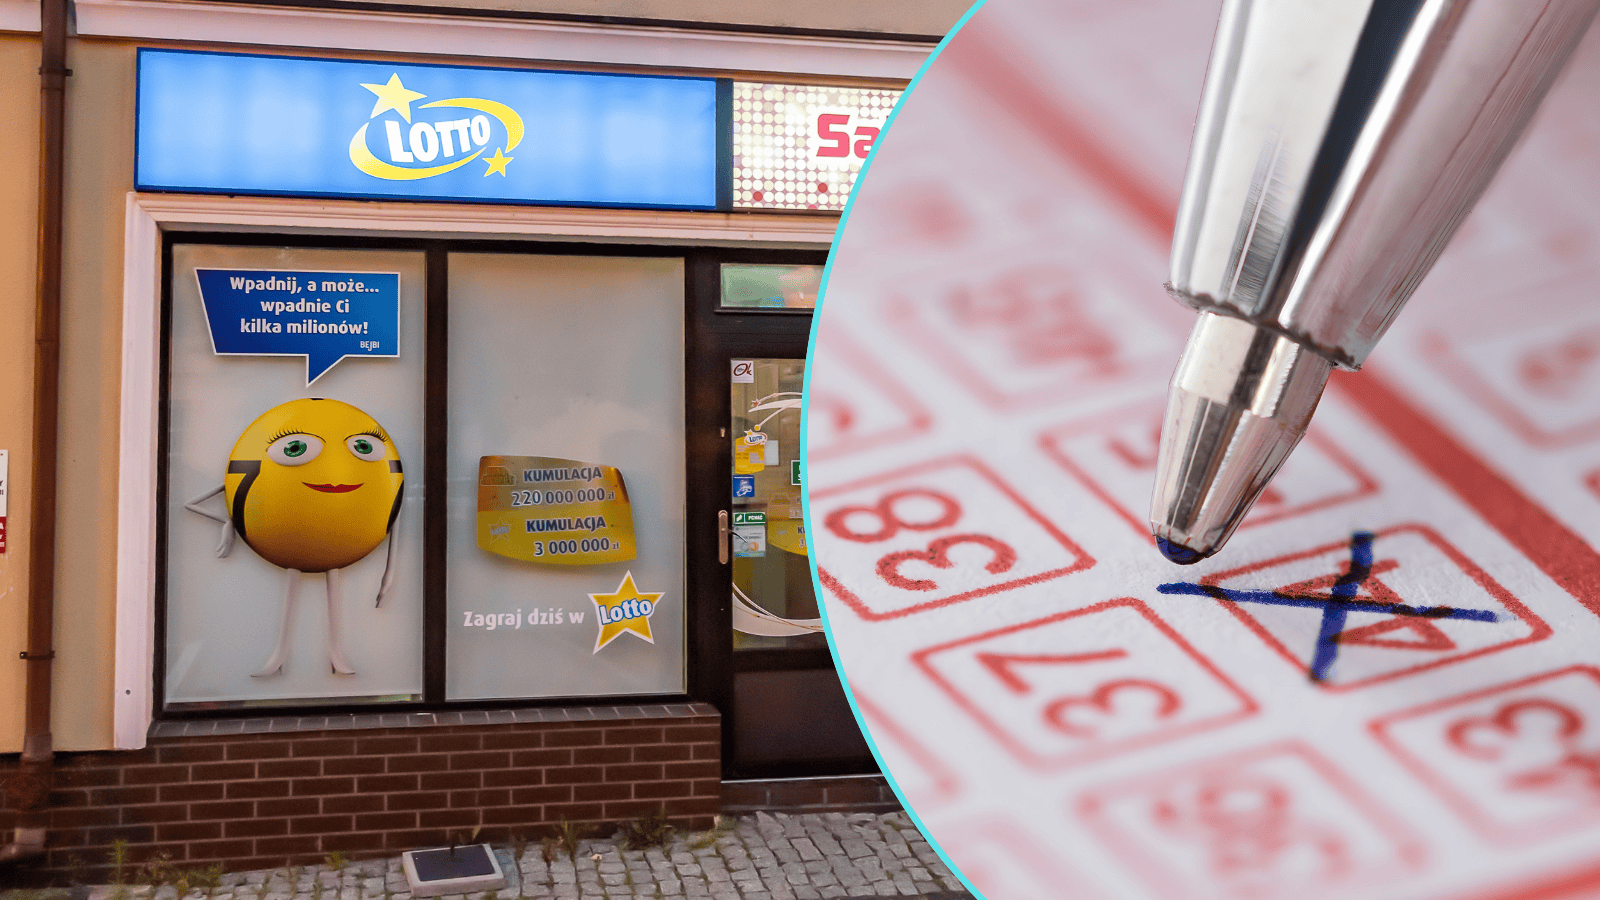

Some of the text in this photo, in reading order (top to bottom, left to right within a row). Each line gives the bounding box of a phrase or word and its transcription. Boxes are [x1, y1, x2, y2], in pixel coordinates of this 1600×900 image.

[385, 115, 490, 162] LOTTO
[230, 276, 379, 294] Wpadnij, a może...
[260, 298, 350, 315] wpadnie Ci
[240, 318, 369, 335] kilka milionów!
[360, 341, 380, 351] BEJBI
[524, 467, 602, 482] KUMULACJA
[512, 490, 542, 506] 220
[545, 489, 573, 504] 000
[577, 487, 605, 503] 000
[526, 516, 606, 532] KUMULACJA
[534, 541, 544, 556] 3
[549, 540, 577, 554] 000
[581, 537, 610, 552] 000
[824, 487, 1017, 592] 38
[463, 598, 653, 630] Zagraj dziś w Lotto
[973, 647, 1184, 737] 37
